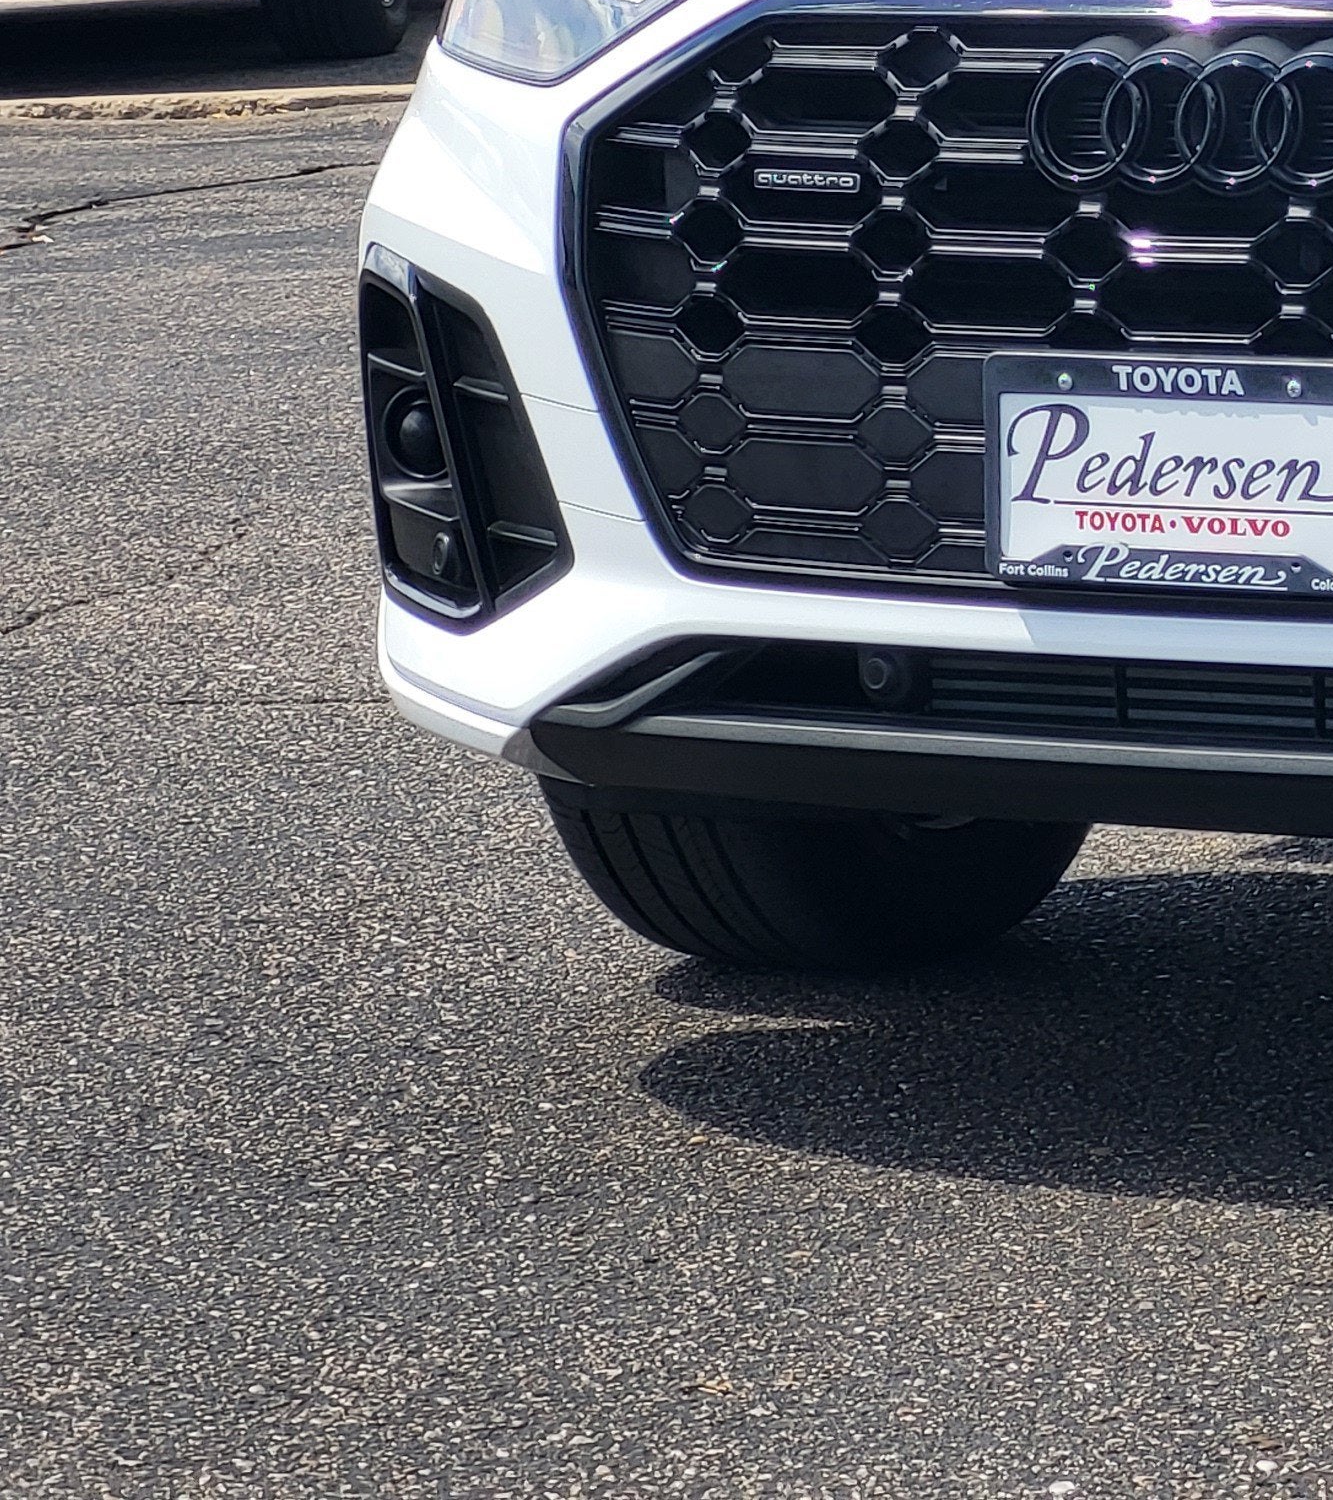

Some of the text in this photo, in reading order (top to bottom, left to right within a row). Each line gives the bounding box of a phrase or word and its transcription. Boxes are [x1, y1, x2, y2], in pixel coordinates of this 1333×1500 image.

[757, 172, 854, 187] quattro
[1111, 364, 1246, 397] TOYOTA
[1074, 510, 1291, 538] TOYOTA VOLVO
[998, 562, 1070, 578] Fort Collins
[1076, 541, 1288, 585] Pedersen
